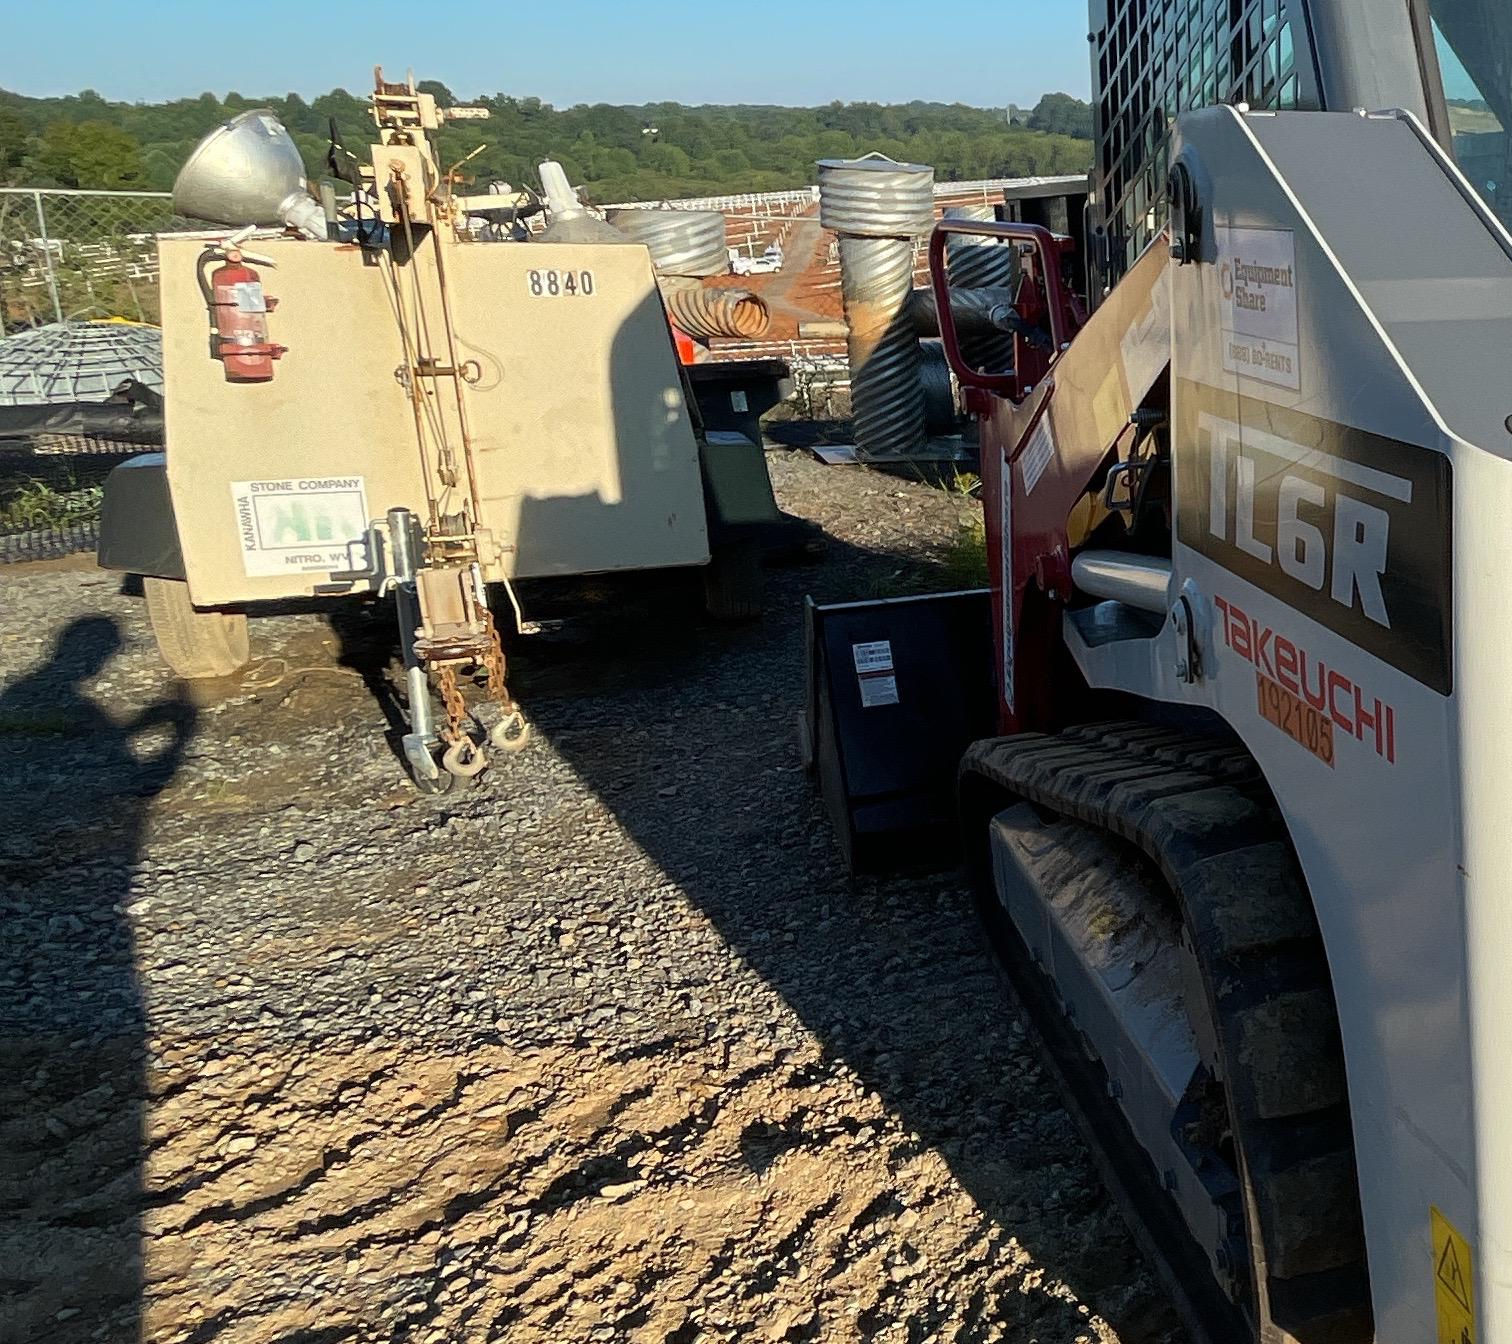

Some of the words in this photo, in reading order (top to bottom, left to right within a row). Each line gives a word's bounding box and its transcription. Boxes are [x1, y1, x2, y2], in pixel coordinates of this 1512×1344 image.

[529, 269, 594, 297] 8840
[1233, 257, 1294, 289] Equipment
[1234, 285, 1267, 312] Share
[250, 481, 294, 493] STONE
[298, 479, 361, 491] COMPANY
[237, 495, 257, 552] KANAWHA
[1199, 410, 1413, 630] TL6R
[1213, 594, 1395, 765] TAKEUCHI
[1257, 674, 1335, 765] 192105
